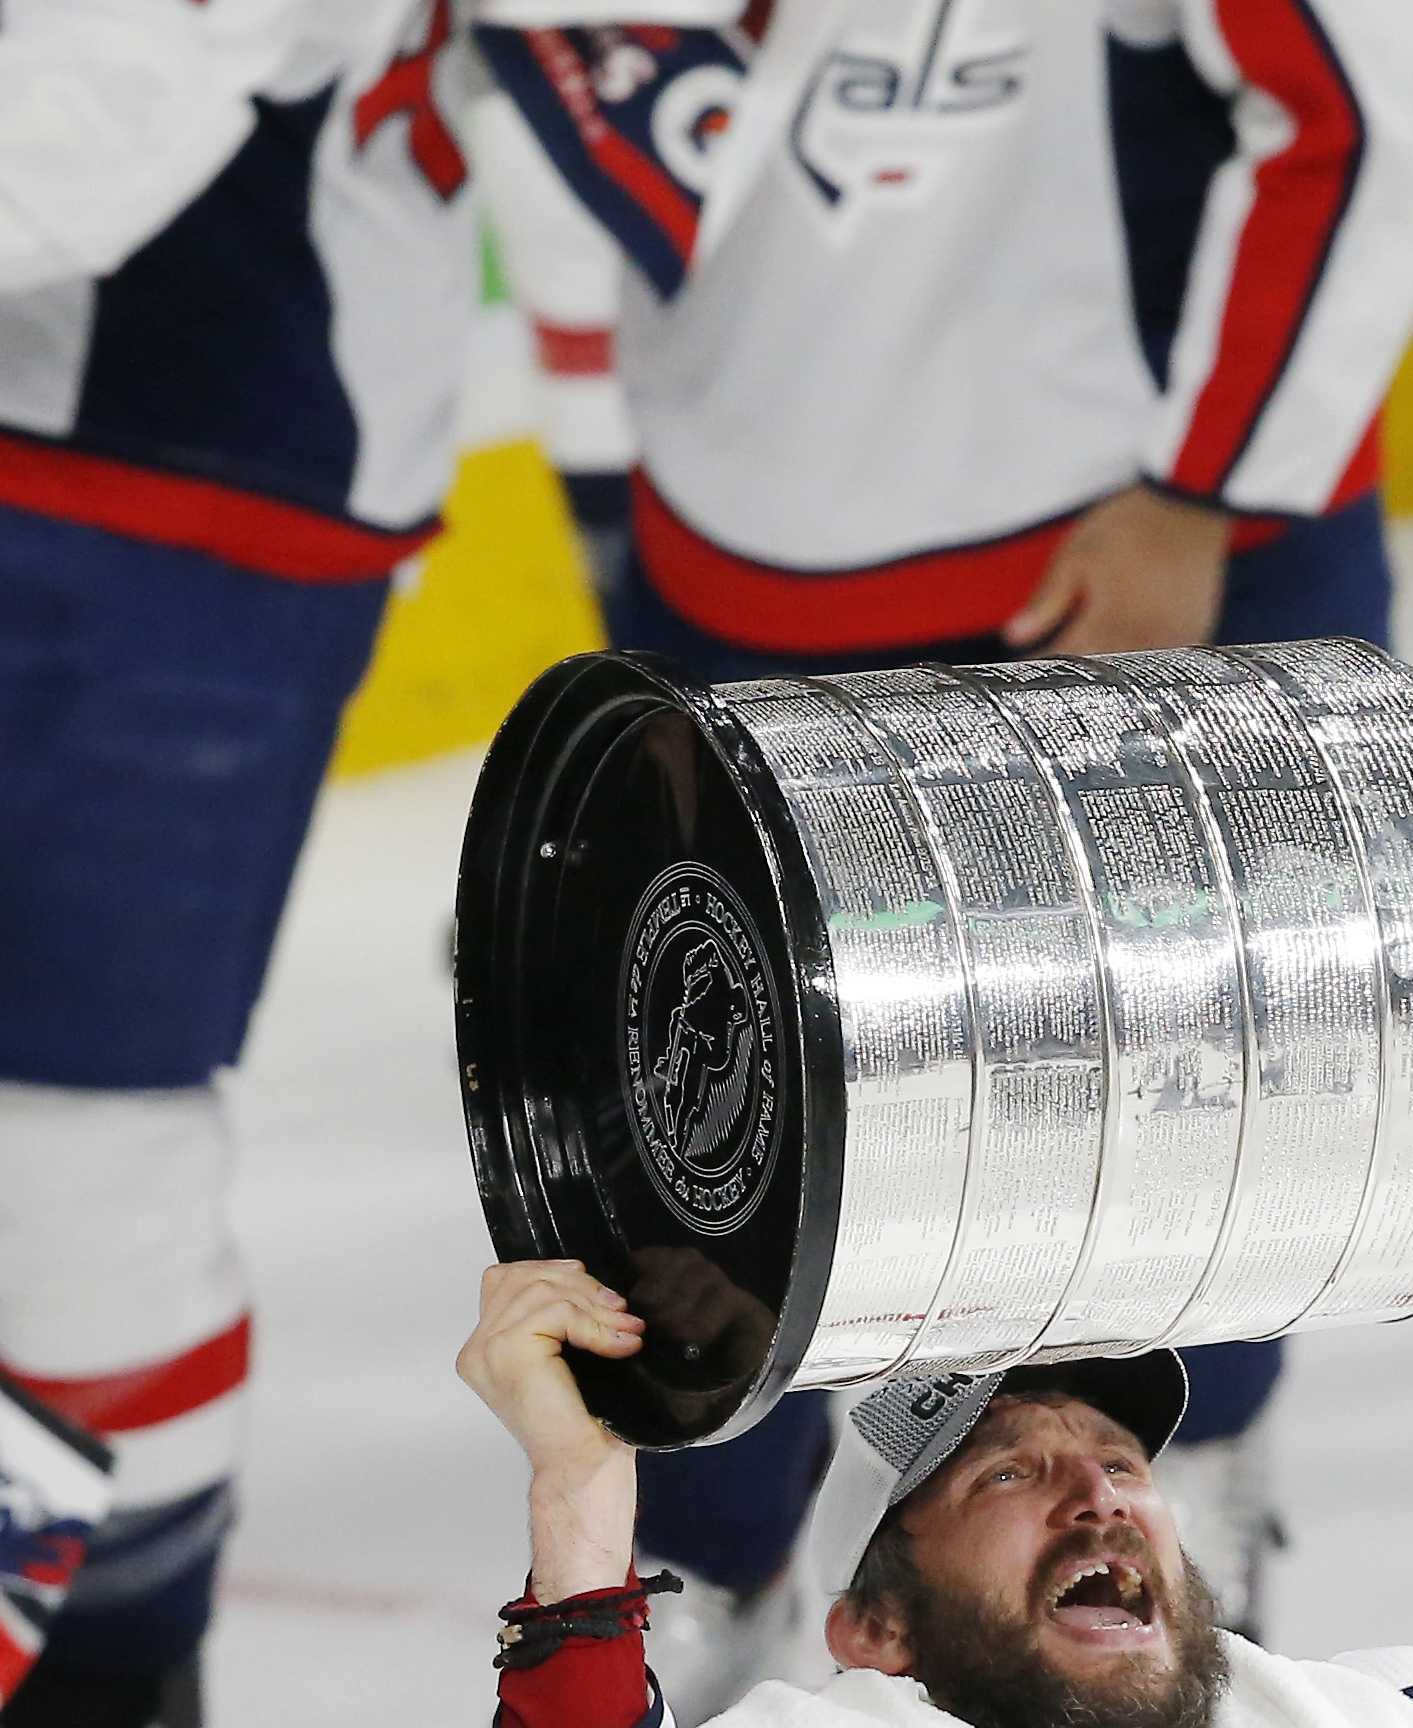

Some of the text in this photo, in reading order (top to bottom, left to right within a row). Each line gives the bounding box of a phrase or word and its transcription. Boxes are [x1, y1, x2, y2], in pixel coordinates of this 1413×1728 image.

[705, 892, 757, 970] HOCKEY
[636, 892, 681, 966] TEMPLE
[692, 1167, 747, 1211] HOCKEY
[750, 972, 773, 1052] HALL
[751, 1090, 774, 1166] FAME
